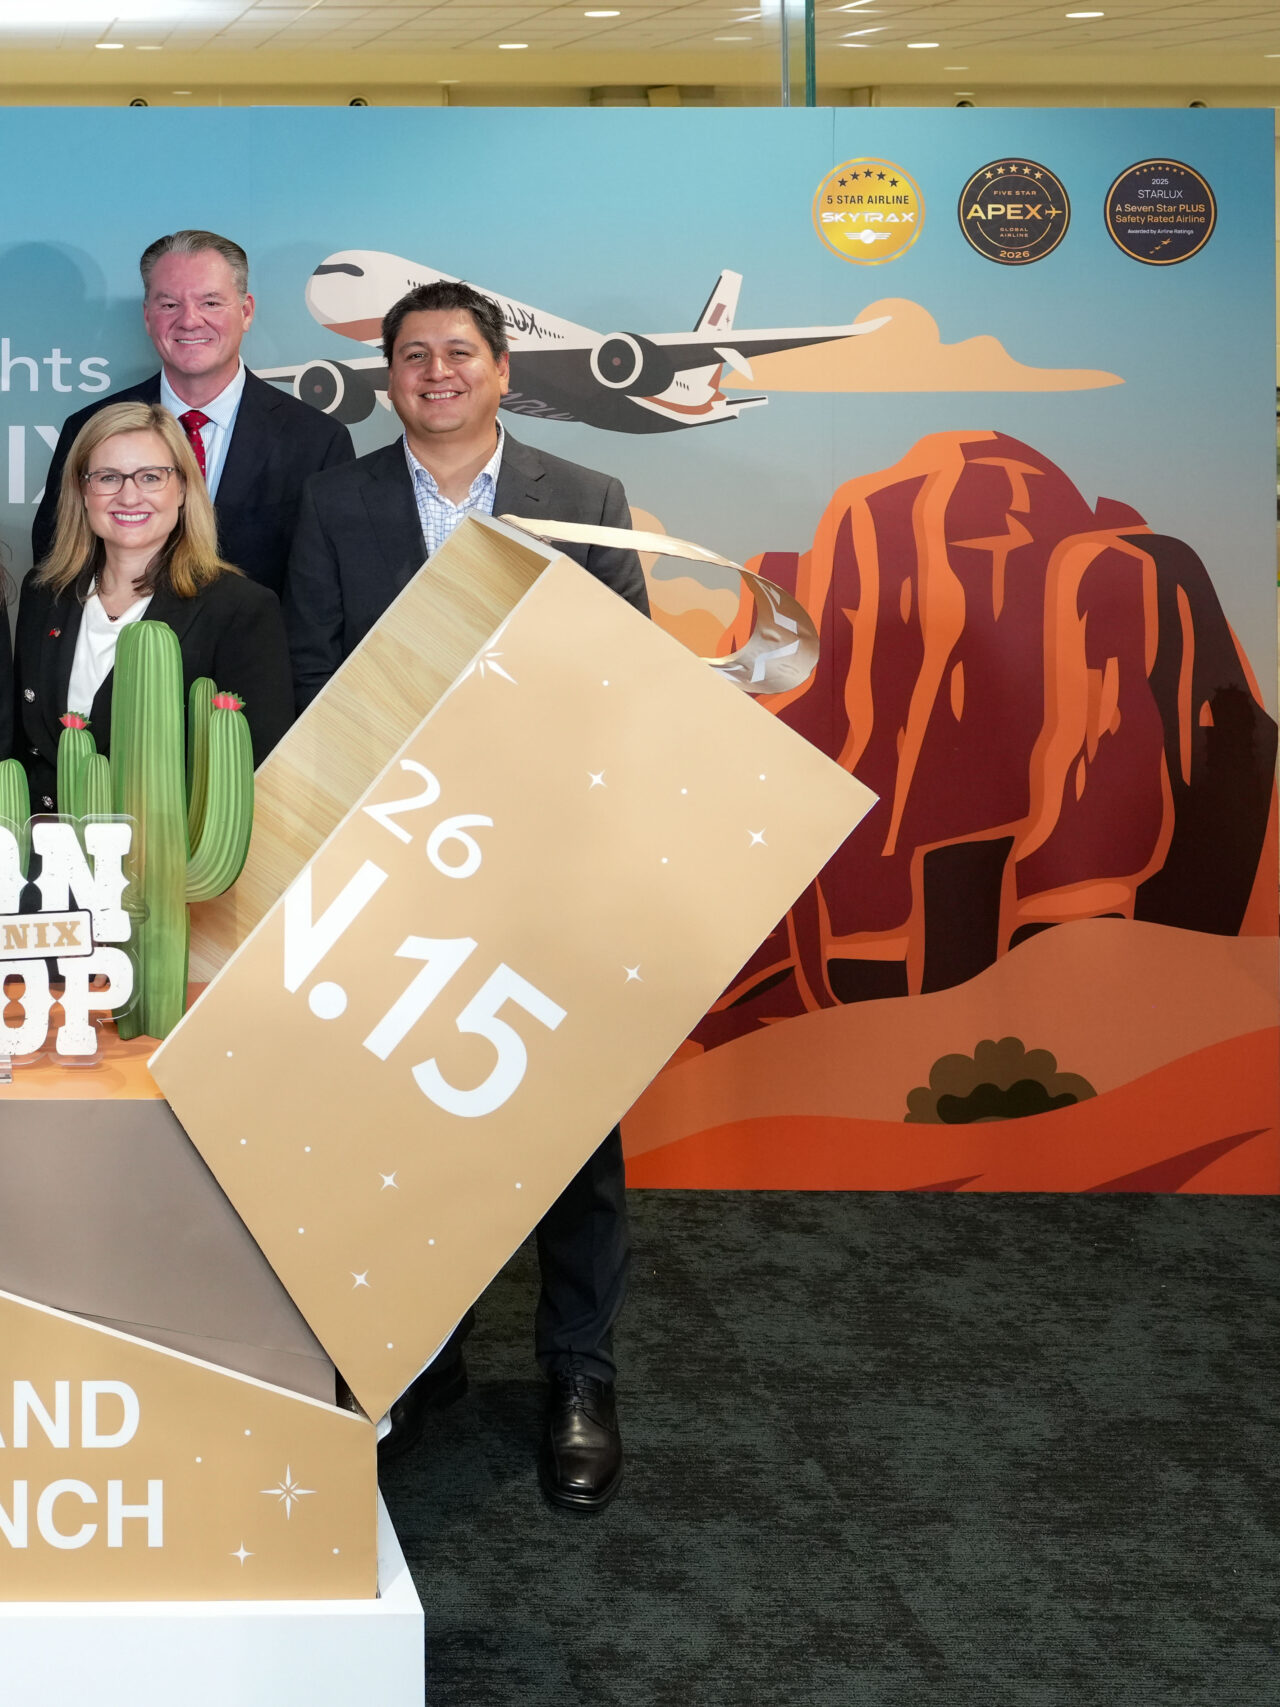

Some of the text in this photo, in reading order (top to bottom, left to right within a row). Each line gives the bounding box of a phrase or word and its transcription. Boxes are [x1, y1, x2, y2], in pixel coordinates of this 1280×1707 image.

[1137, 189, 1184, 199] STARLUX
[827, 195, 909, 205] 5 STAR AIRLINE
[966, 203, 1043, 220] APEX
[1115, 204, 1205, 213] A Seven Star PLUS
[821, 212, 915, 223] SKYTRAX
[1115, 215, 1205, 225] Safety Rated Airline
[999, 250, 1030, 259] 2026
[361, 759, 494, 879] 26
